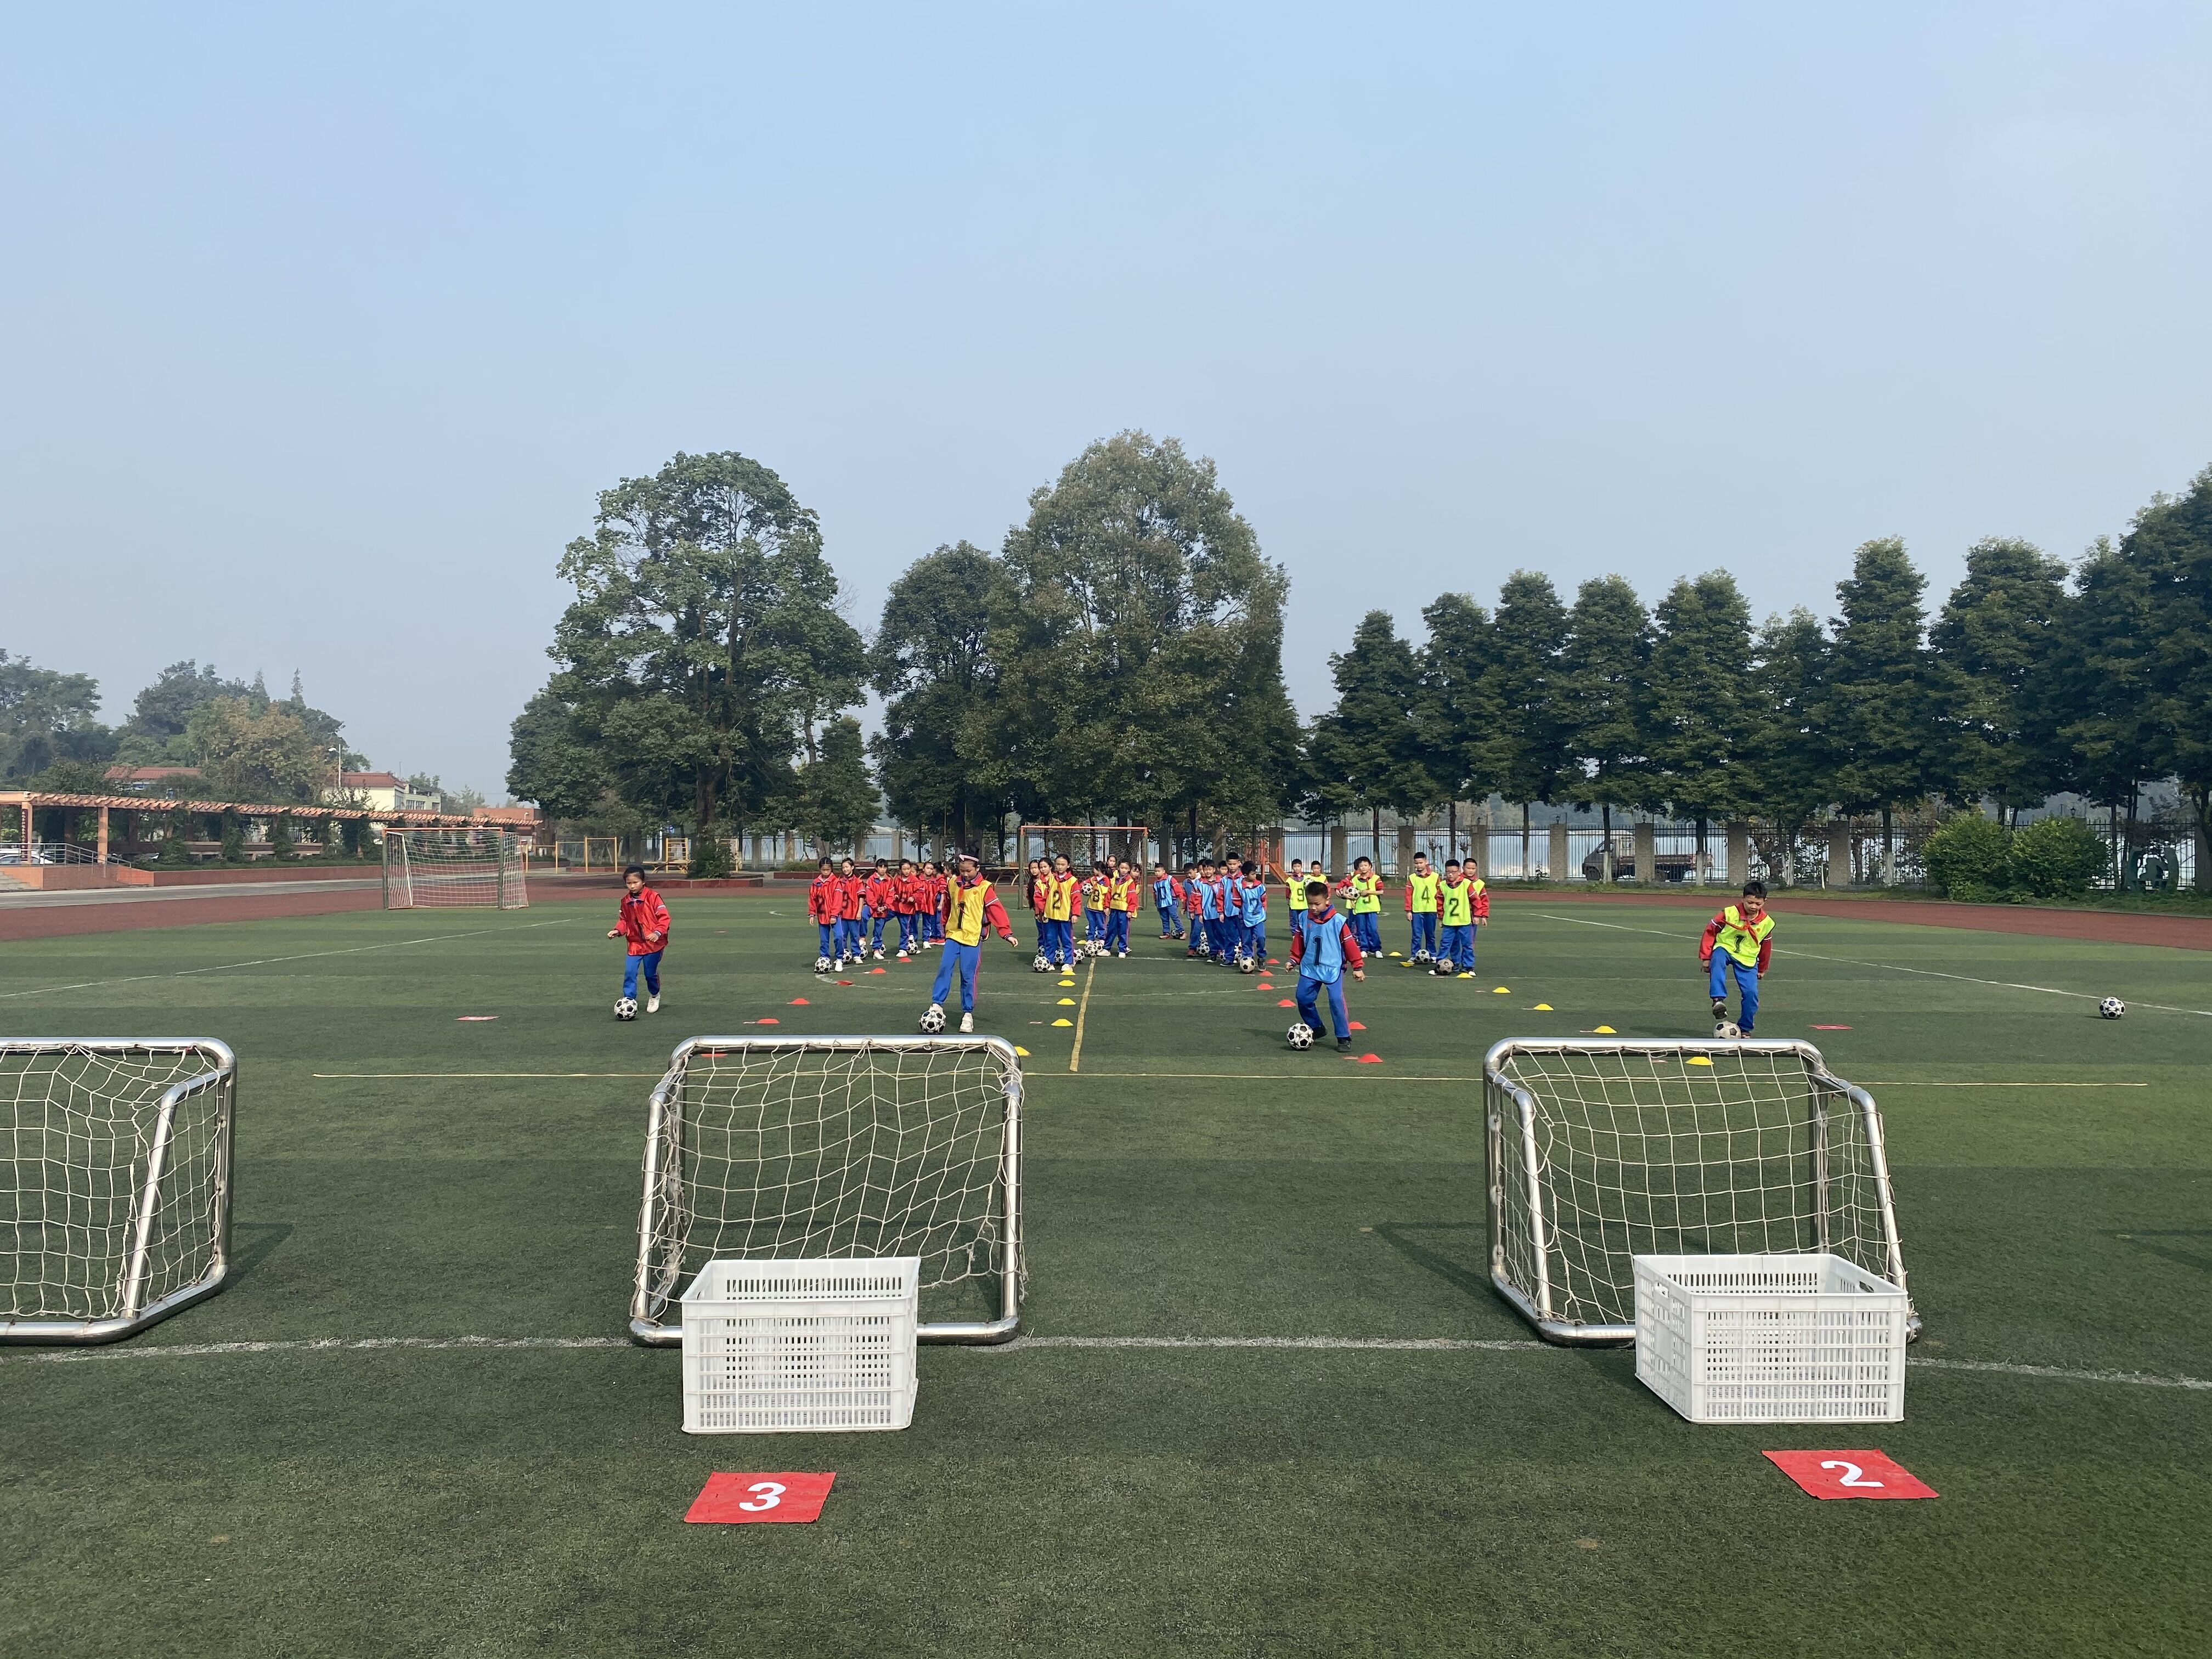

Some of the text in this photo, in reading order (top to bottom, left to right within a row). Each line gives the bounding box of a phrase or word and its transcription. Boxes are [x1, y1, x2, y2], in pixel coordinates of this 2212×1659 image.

[1052, 890, 1060, 910] 2
[1297, 888, 1305, 902] 9
[1421, 885, 1430, 904] 4
[957, 901, 966, 929] 1
[1449, 897, 1460, 918] 2
[1312, 935, 1323, 967] 1
[1733, 934, 1746, 953] 1
[1820, 1460, 1885, 1487] 2
[739, 1482, 787, 1511] 3
